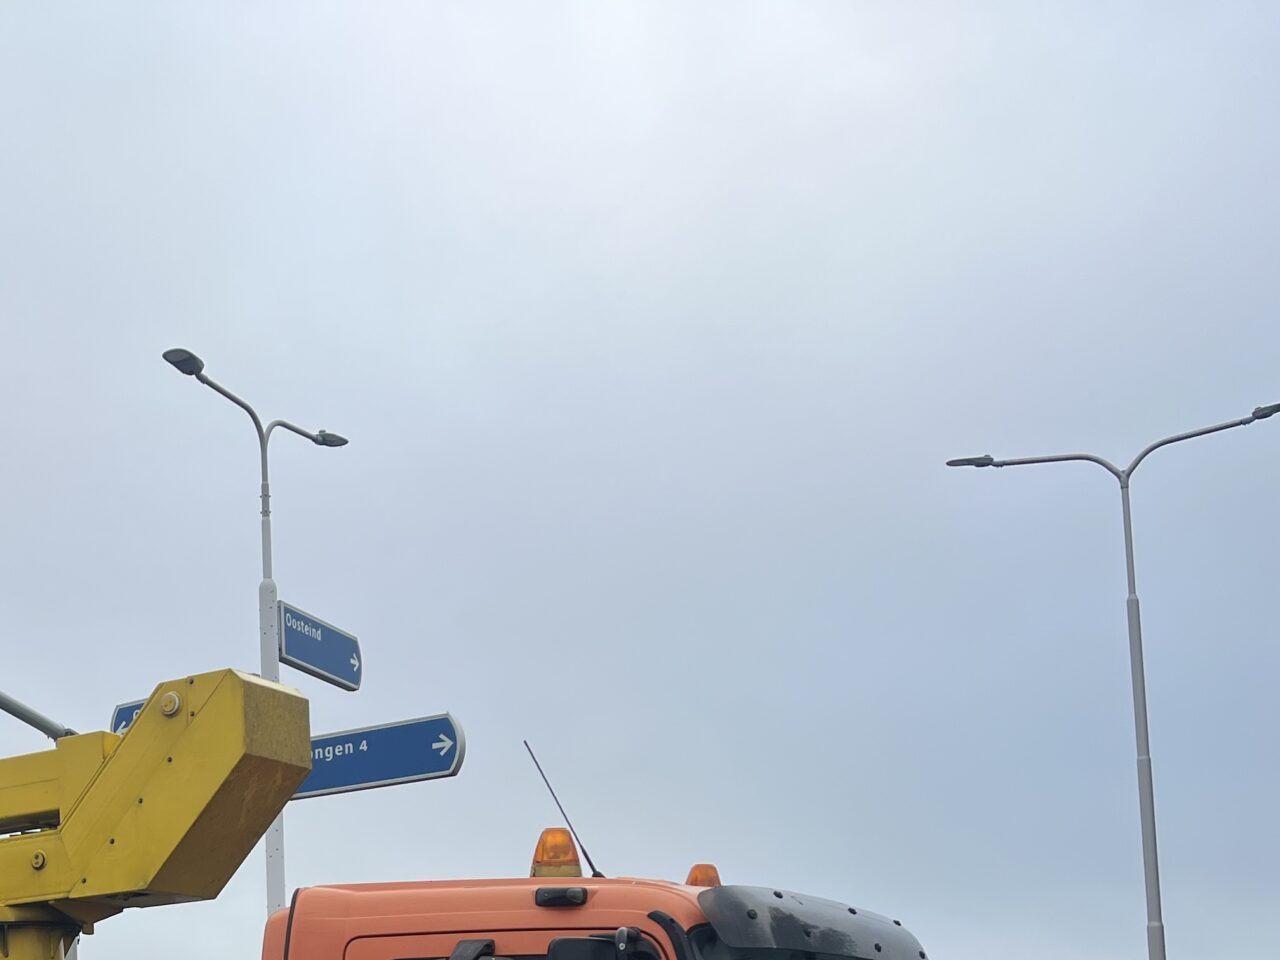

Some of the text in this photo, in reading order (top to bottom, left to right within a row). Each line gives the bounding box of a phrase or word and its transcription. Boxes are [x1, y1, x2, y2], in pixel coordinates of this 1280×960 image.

[285, 613, 322, 641] Oosteind
[310, 739, 369, 762] ngen 4
